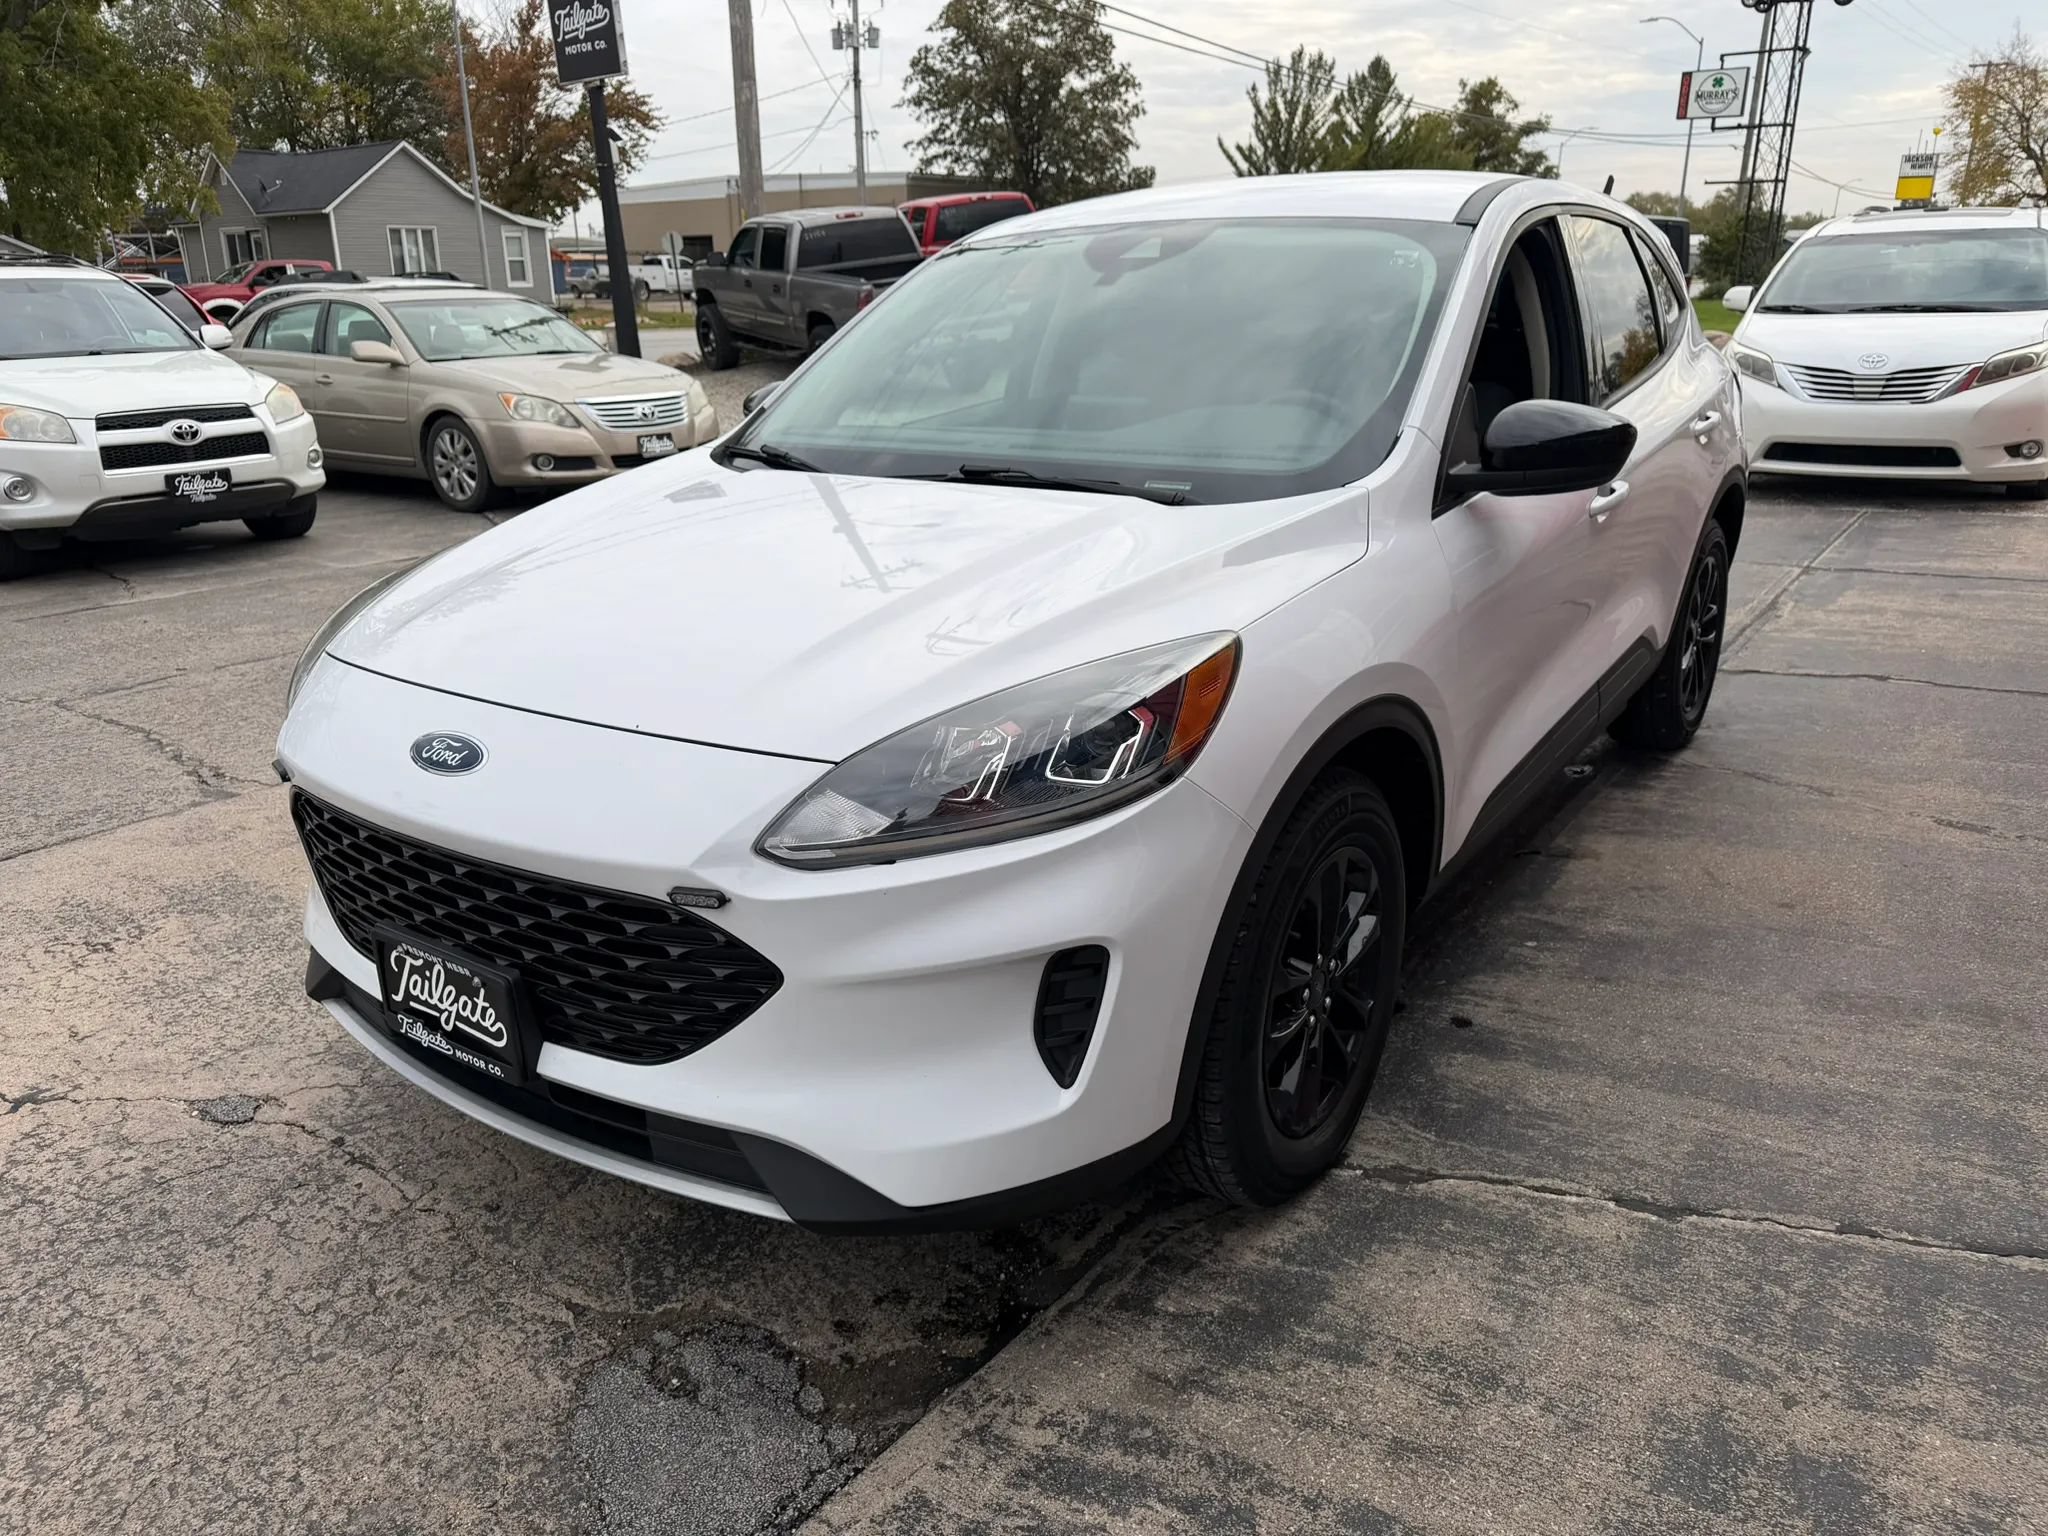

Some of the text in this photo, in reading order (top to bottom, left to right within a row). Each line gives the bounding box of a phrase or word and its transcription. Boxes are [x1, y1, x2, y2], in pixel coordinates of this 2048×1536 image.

[554, 0, 610, 42] Tailgate
[564, 41, 593, 56] MOTOR
[1904, 154, 1934, 164] JACKSON
[1910, 162, 1932, 170] HEWITT
[174, 471, 229, 496] Tailgate
[421, 737, 469, 766] Ford
[401, 942, 444, 967] FREMONT
[390, 948, 508, 1048] Tailgate
[397, 1013, 505, 1078] Tailgate MOTOR CO.
